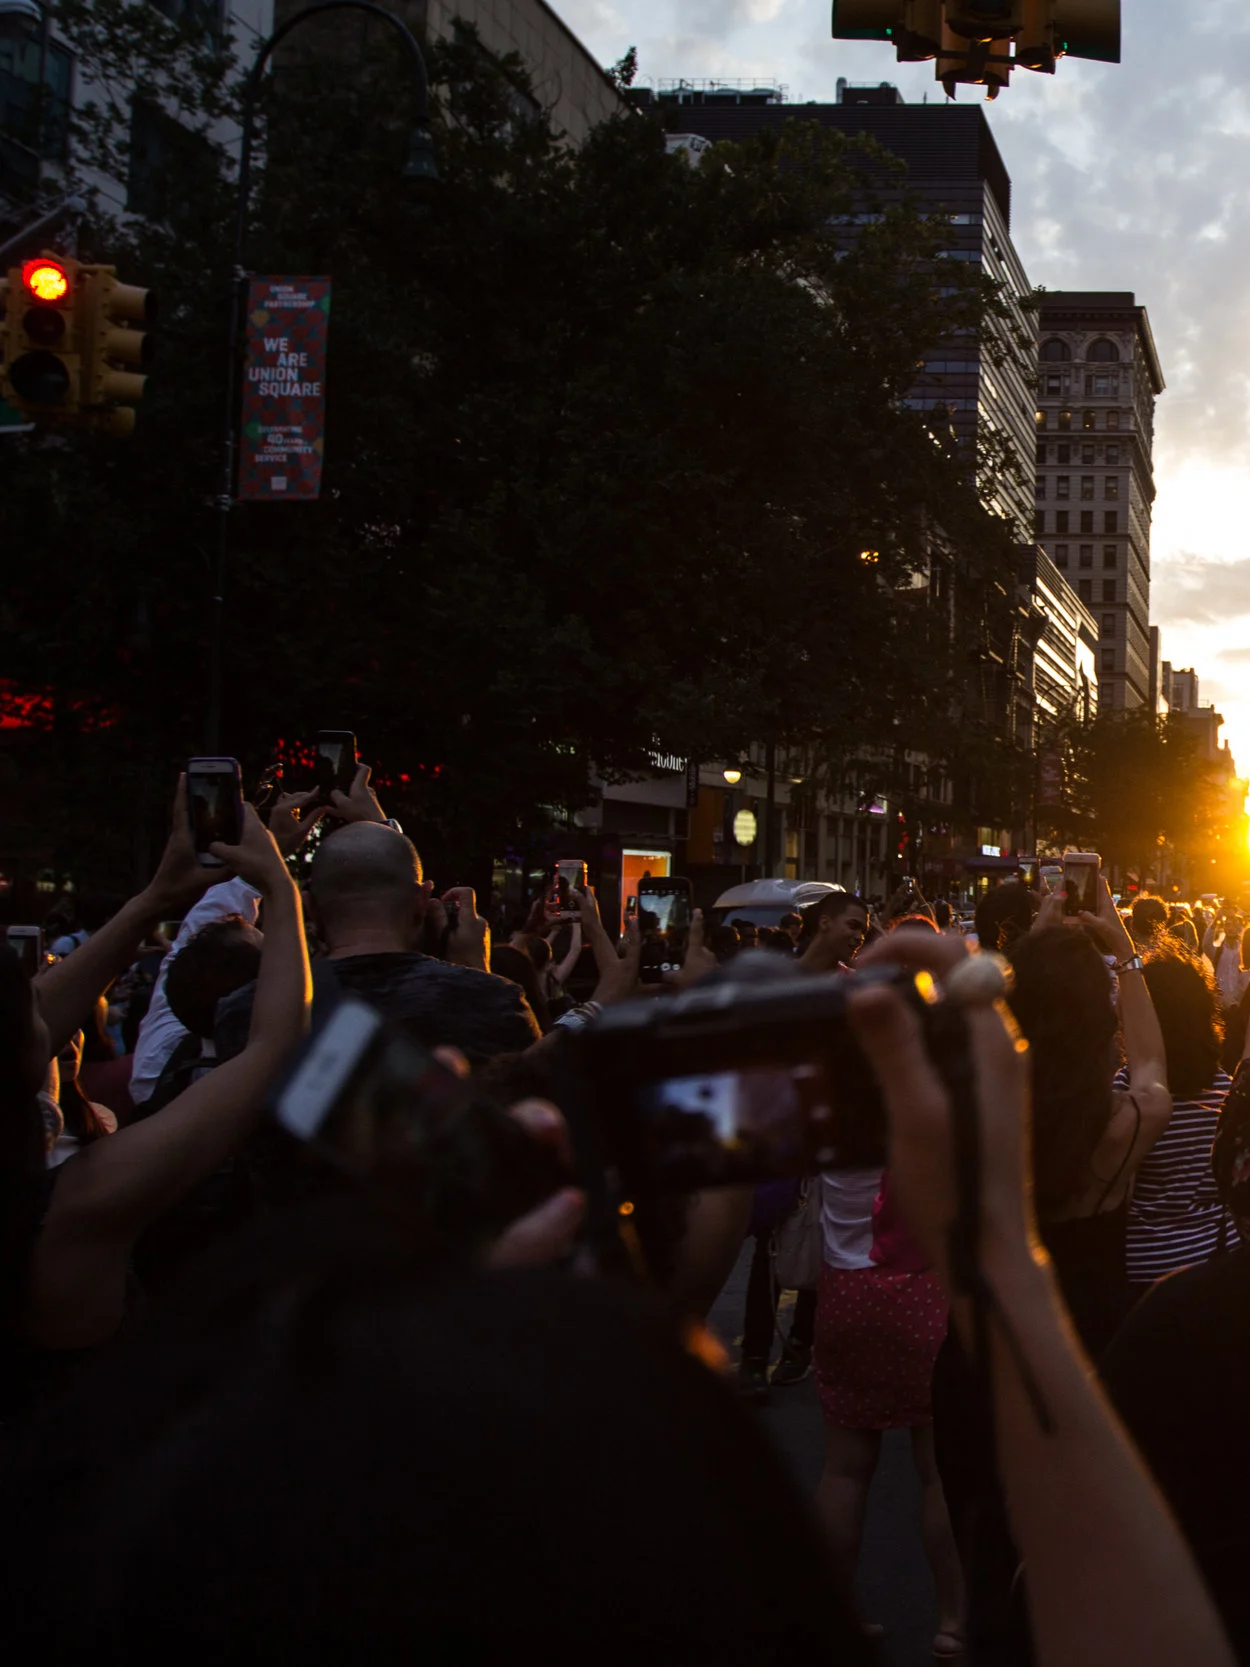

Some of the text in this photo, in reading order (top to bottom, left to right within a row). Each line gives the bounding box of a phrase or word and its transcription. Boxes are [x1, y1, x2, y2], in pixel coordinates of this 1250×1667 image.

[264, 337, 289, 352] WE
[277, 352, 308, 367] ARE
[248, 367, 299, 381] UNION
[259, 382, 321, 398] SQUARE
